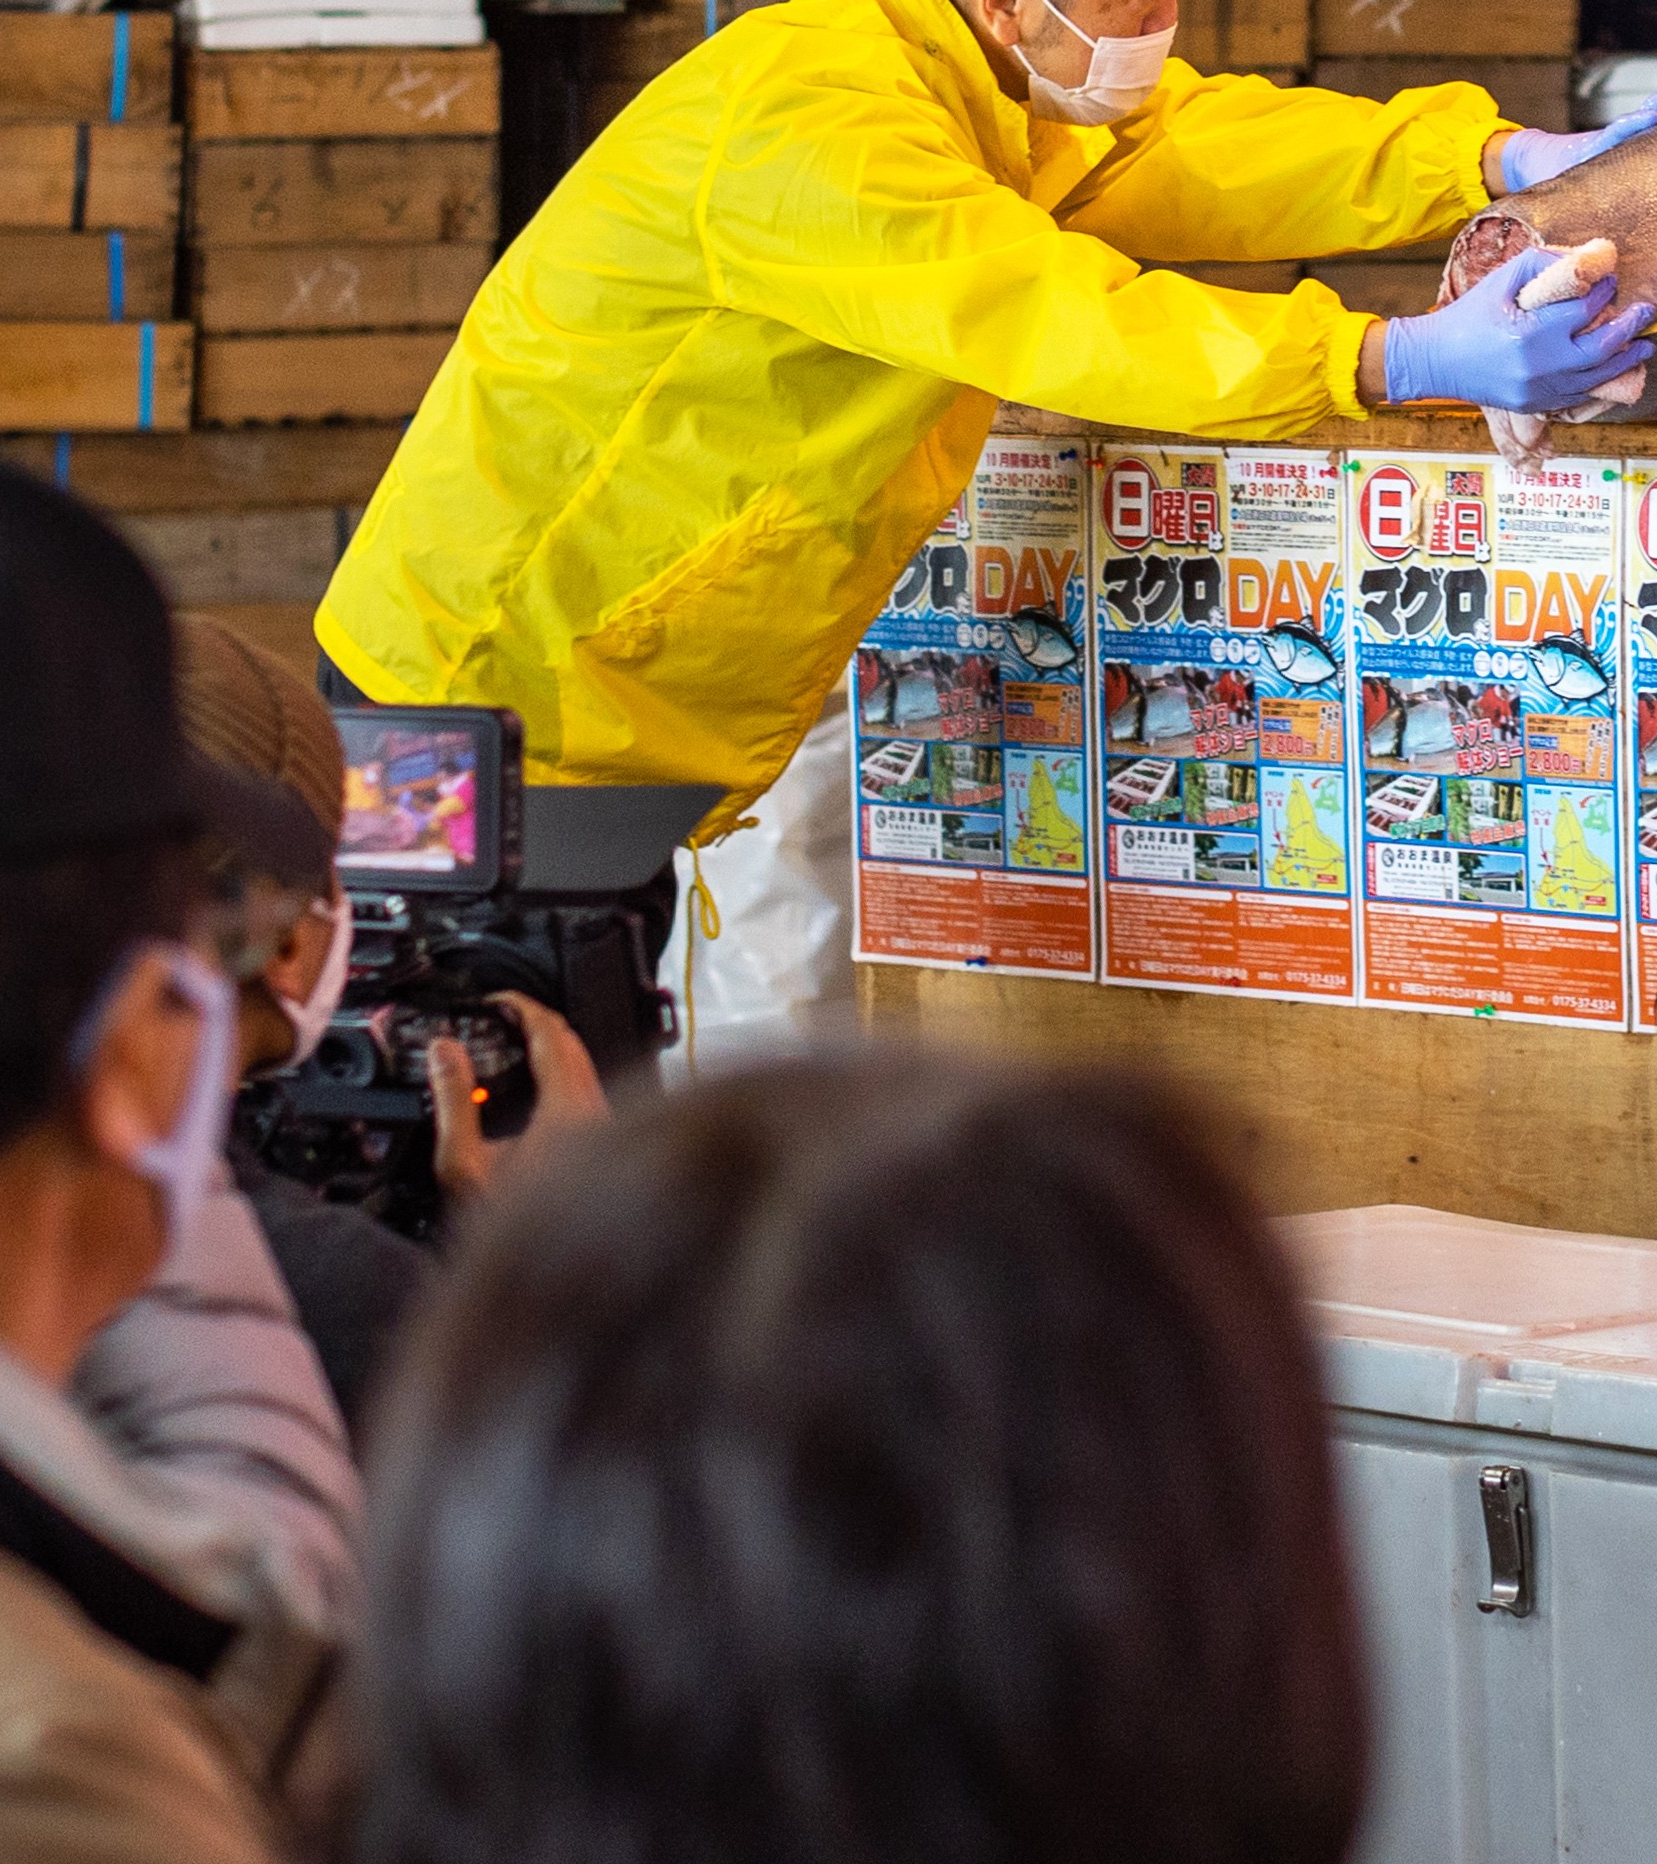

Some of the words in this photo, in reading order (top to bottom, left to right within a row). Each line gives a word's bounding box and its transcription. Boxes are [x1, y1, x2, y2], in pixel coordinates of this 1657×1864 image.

[974, 545, 1079, 619] DAY
[1228, 557, 1339, 634] DAY
[1493, 568, 1610, 649] DAY
